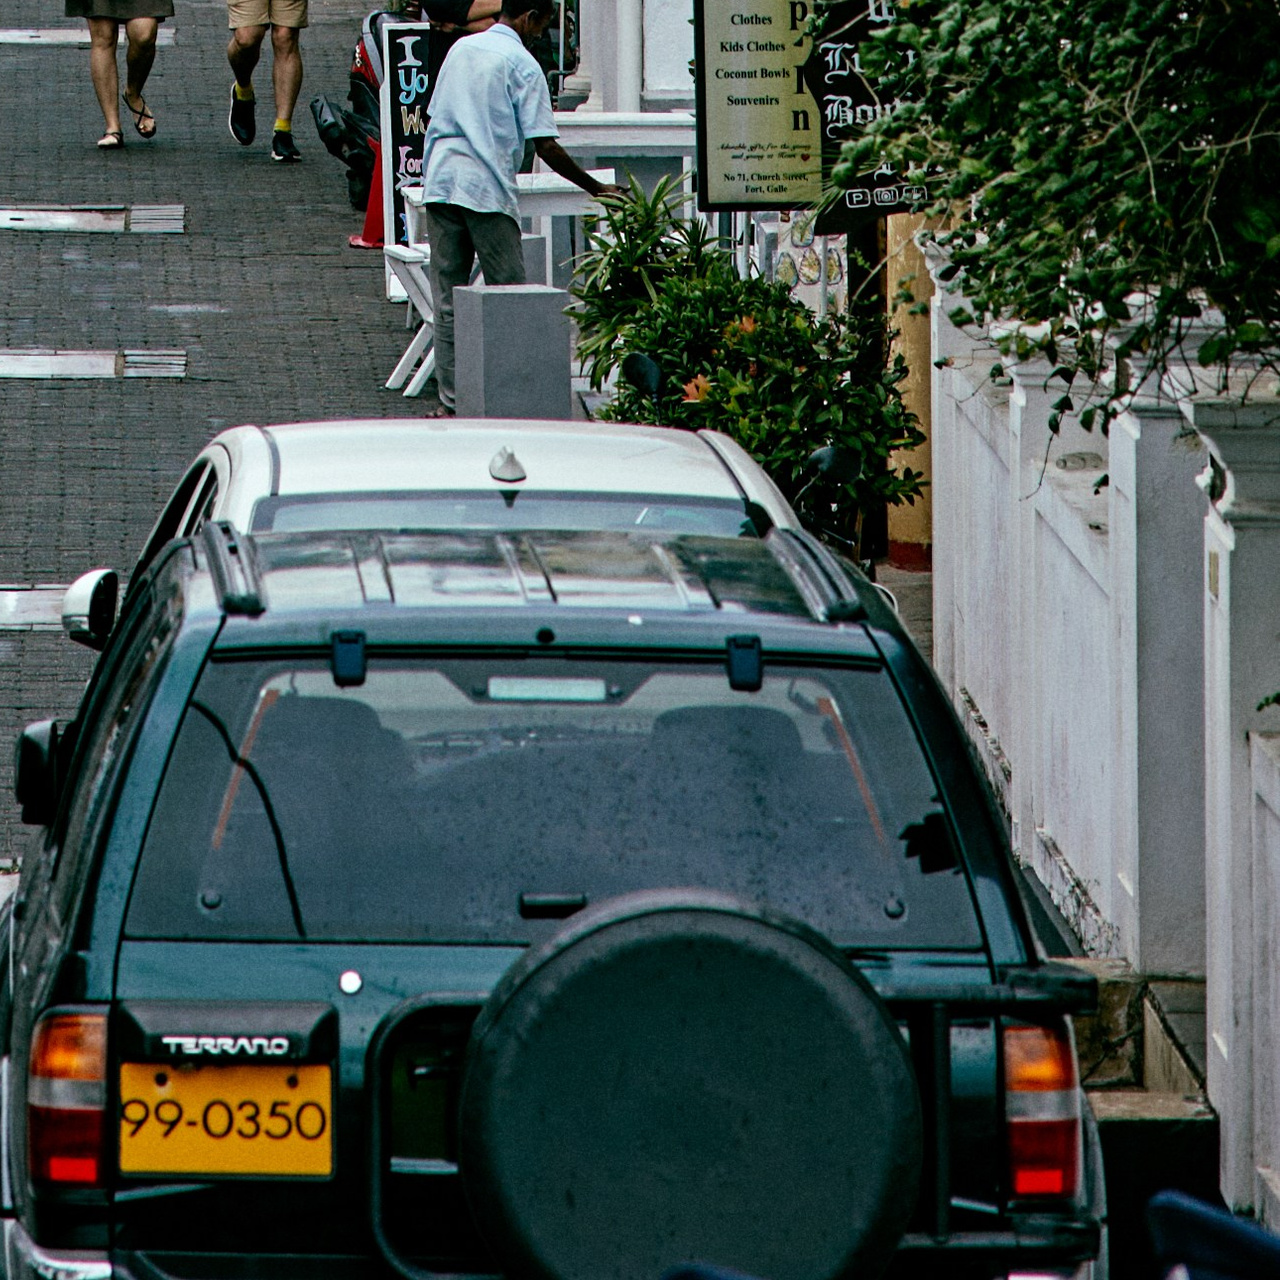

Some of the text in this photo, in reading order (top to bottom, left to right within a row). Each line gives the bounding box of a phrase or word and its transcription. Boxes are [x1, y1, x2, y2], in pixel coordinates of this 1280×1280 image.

[730, 14, 773, 26] Clothes
[720, 41, 786, 52] Kids Clothes
[715, 67, 791, 79] Coconut Bowls
[726, 95, 780, 106] Souvenirs
[723, 173, 736, 182] No
[750, 173, 781, 181] Church
[766, 185, 788, 193] Galle
[162, 1036, 290, 1055] TERRANO
[120, 1096, 328, 1142] 99-0350
